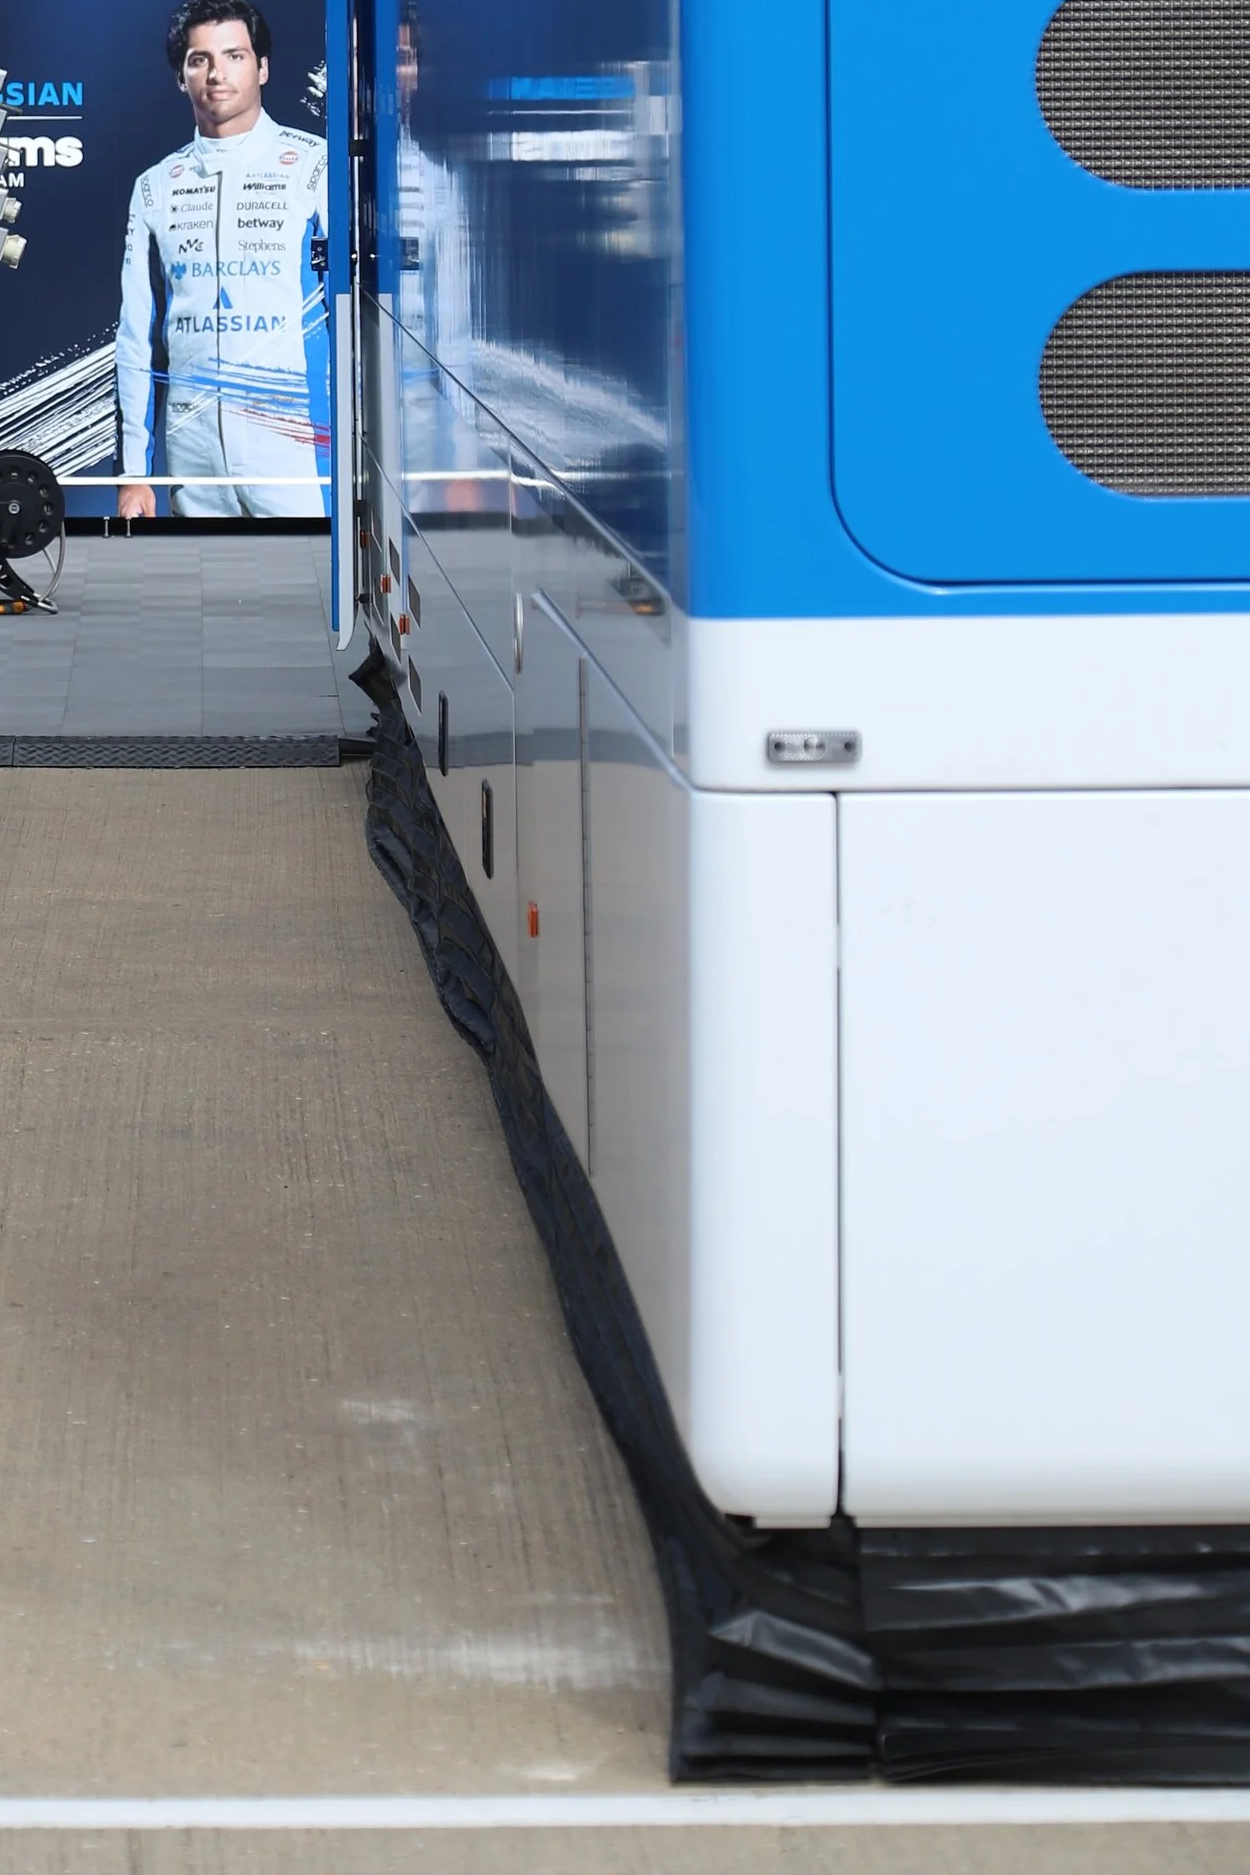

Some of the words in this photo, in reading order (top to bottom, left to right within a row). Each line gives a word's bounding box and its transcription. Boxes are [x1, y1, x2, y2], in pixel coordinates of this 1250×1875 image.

[172, 185, 216, 196] KOMATSU
[242, 181, 287, 191] Williams
[180, 203, 214, 213] Claude
[236, 201, 289, 211] DURACELL
[238, 218, 285, 231] betway
[238, 239, 286, 253] Stephens
[191, 260, 281, 278] BARCLAYS
[175, 315, 287, 334] ATLASSIAN
